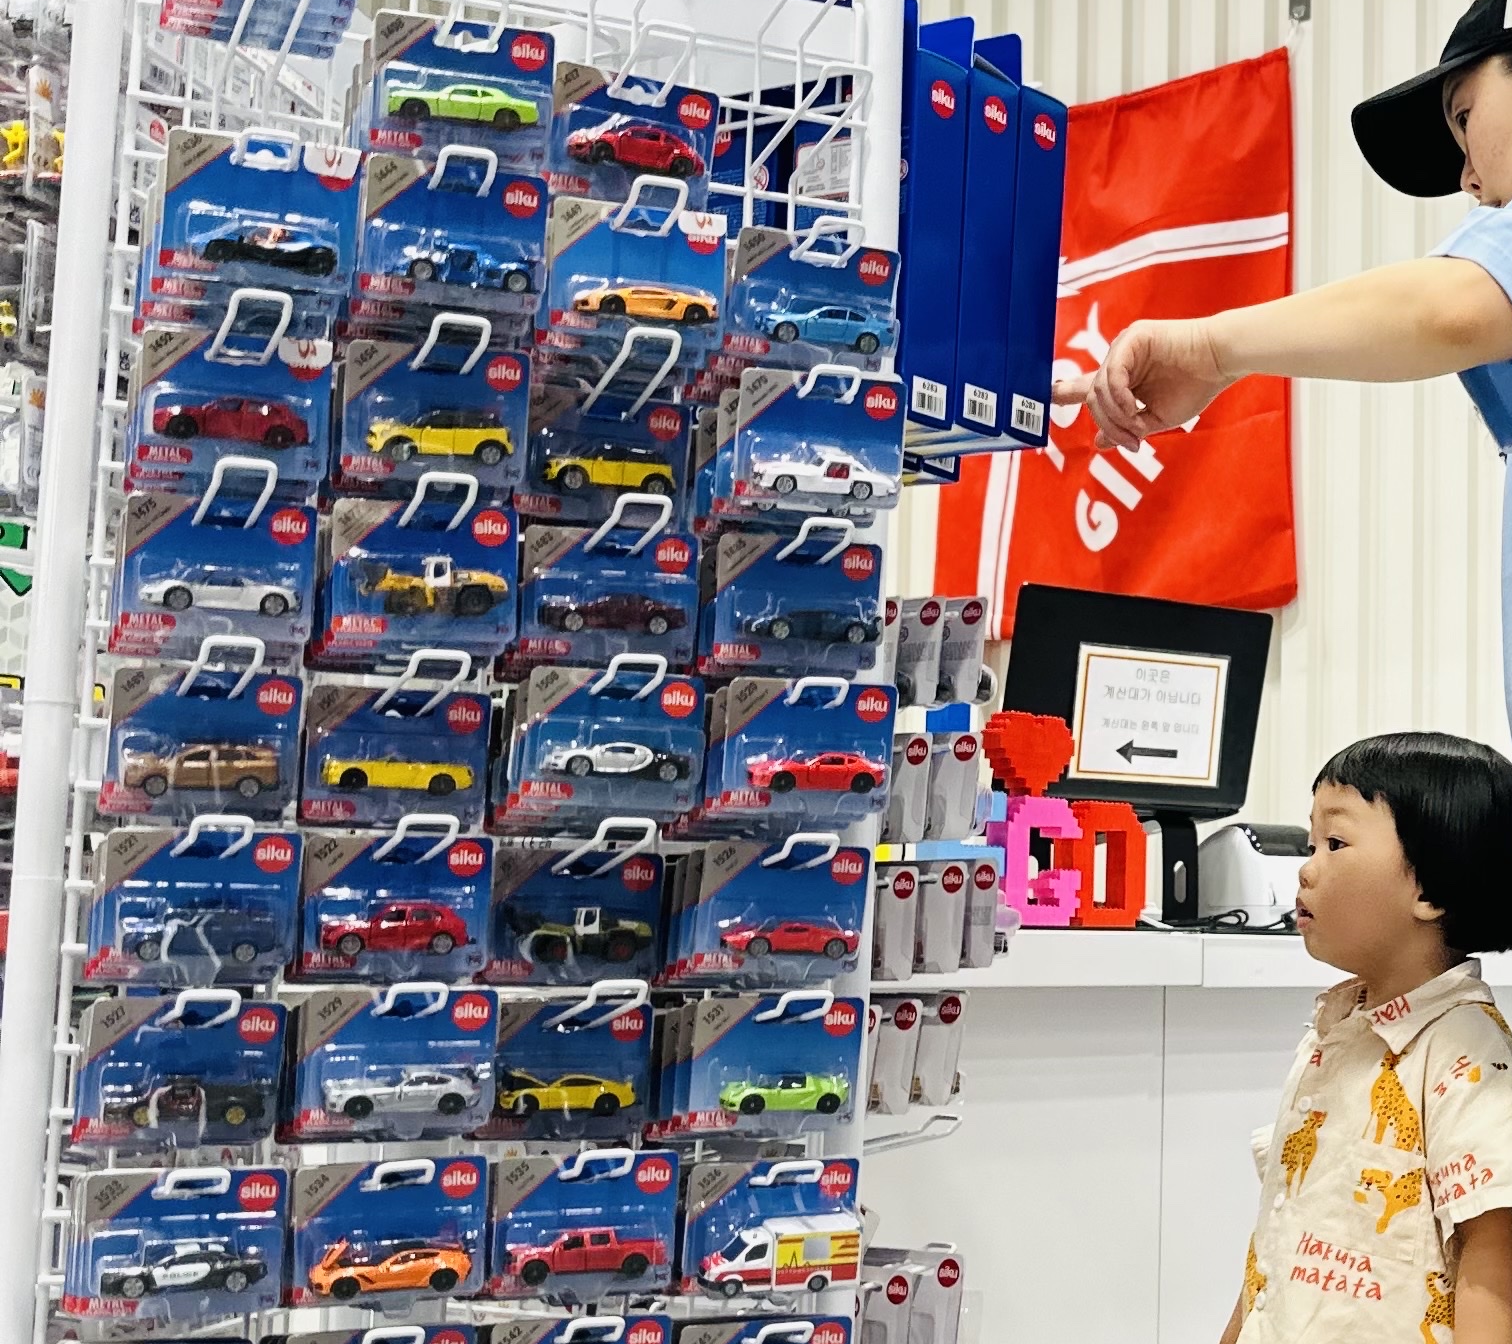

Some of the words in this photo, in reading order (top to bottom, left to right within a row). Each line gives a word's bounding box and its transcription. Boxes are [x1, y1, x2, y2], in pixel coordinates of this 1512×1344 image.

[511, 42, 547, 63] siku
[984, 103, 1007, 126] siku
[1034, 121, 1057, 142] siku
[859, 260, 891, 277] siku
[866, 394, 898, 411] siku
[146, 446, 188, 459] METAL
[272, 517, 308, 536] siku
[473, 520, 508, 536] siku
[657, 548, 691, 565] siku
[843, 556, 875, 573] siku
[1135, 667, 1171, 684] 이곳은
[259, 687, 294, 706] siku
[1103, 684, 1152, 702] 계산대가
[1156, 689, 1201, 706] 아닙니다
[857, 697, 890, 712] siku
[447, 707, 481, 723] siku
[256, 846, 292, 864] siku
[832, 860, 864, 875] siku
[453, 1004, 490, 1021] siku
[824, 1011, 857, 1026] siku
[611, 1016, 644, 1031] siku
[442, 1171, 478, 1187] siku
[505, 1161, 530, 1184] 1535
[637, 1166, 671, 1183] siku
[821, 1171, 852, 1185] siku
[240, 1182, 277, 1200] siku
[1290, 1265, 1382, 1302] matata
[628, 1328, 662, 1344] siku
[811, 1329, 844, 1344] siku
